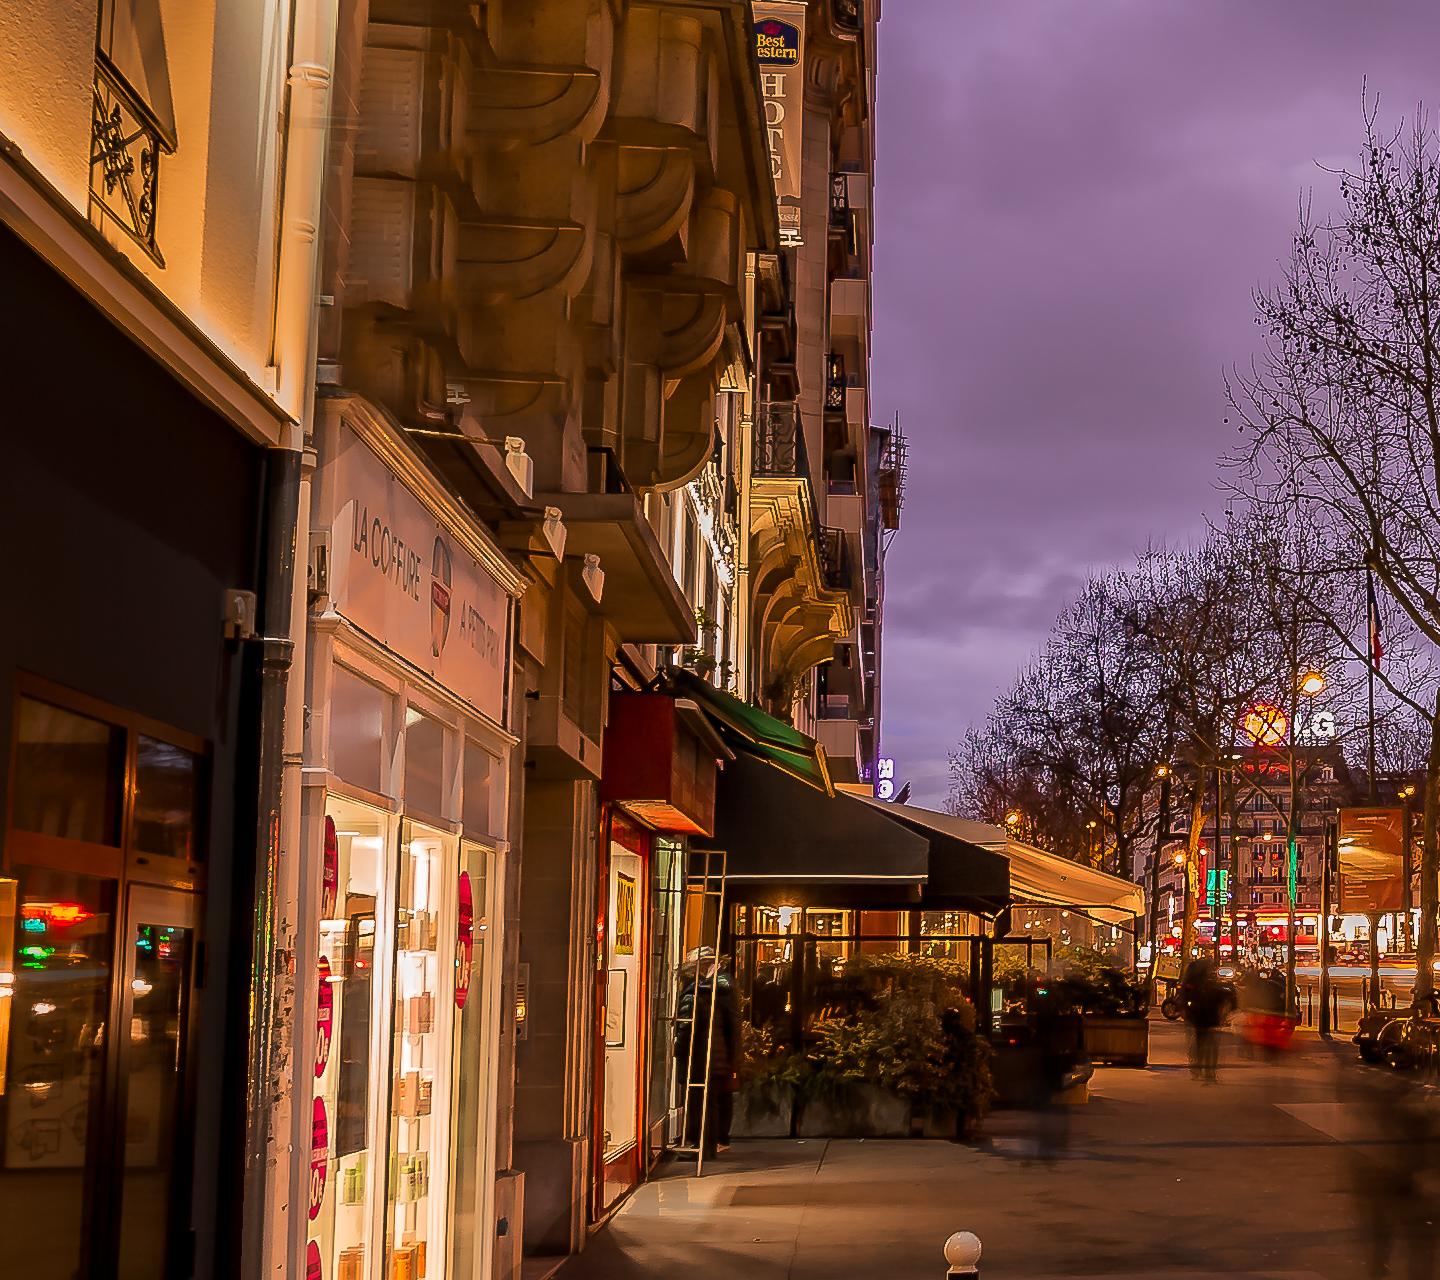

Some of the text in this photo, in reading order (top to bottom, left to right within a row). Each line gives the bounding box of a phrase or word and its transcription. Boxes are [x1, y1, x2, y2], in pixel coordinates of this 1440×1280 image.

[756, 33, 785, 48] Best
[756, 46, 797, 59] estern
[353, 499, 368, 558] LA
